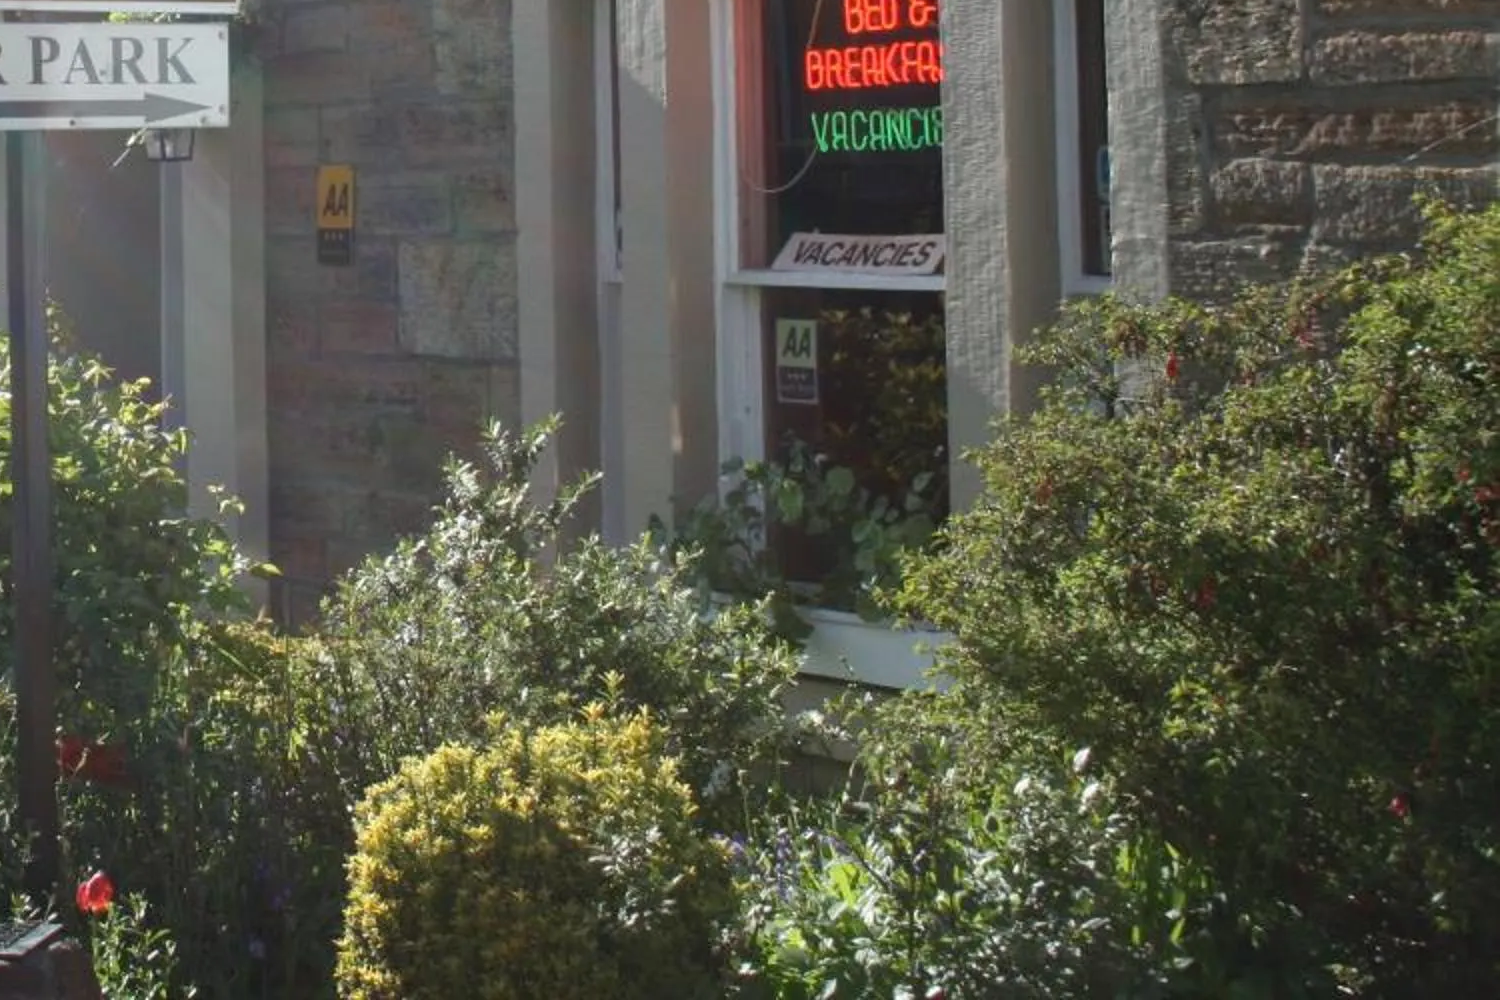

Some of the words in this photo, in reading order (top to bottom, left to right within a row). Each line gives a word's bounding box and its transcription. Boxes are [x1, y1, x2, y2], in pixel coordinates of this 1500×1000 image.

[28, 35, 197, 85] PARK
[806, 41, 945, 89] BREAKFA
[322, 183, 349, 217] AA
[793, 239, 937, 267] VACANCIES
[782, 326, 812, 359] AA
